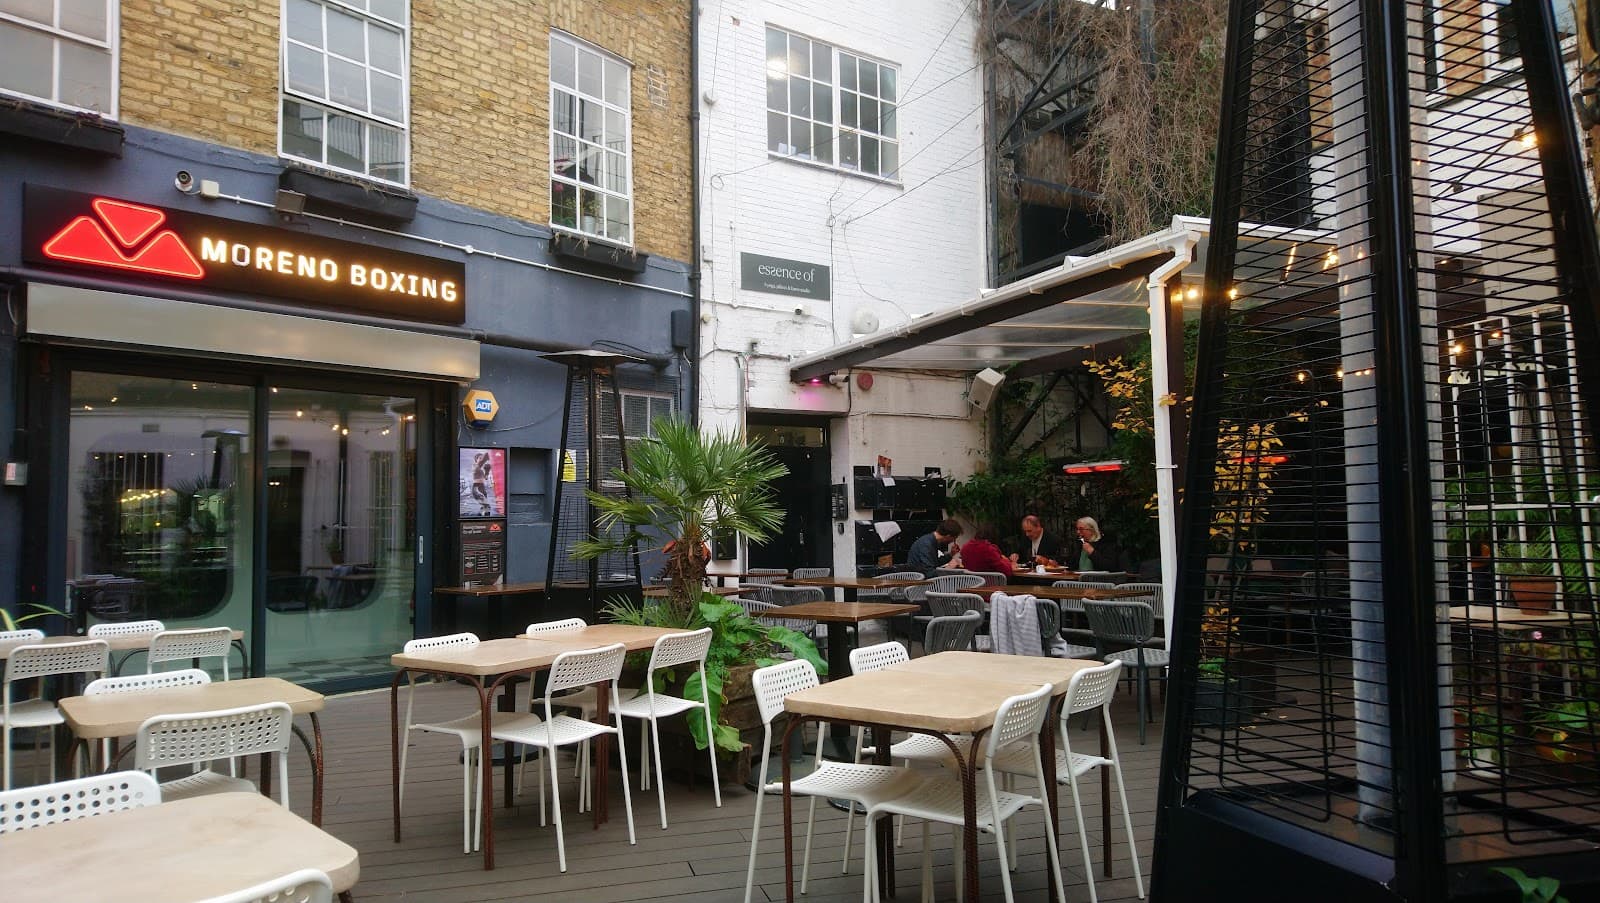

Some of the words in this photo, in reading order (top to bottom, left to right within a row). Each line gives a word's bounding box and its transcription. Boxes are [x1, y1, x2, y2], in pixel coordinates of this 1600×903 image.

[201, 236, 339, 282] MORENO
[350, 264, 458, 302] BOXING
[803, 268, 815, 282] of
[477, 402, 492, 411] ADT
